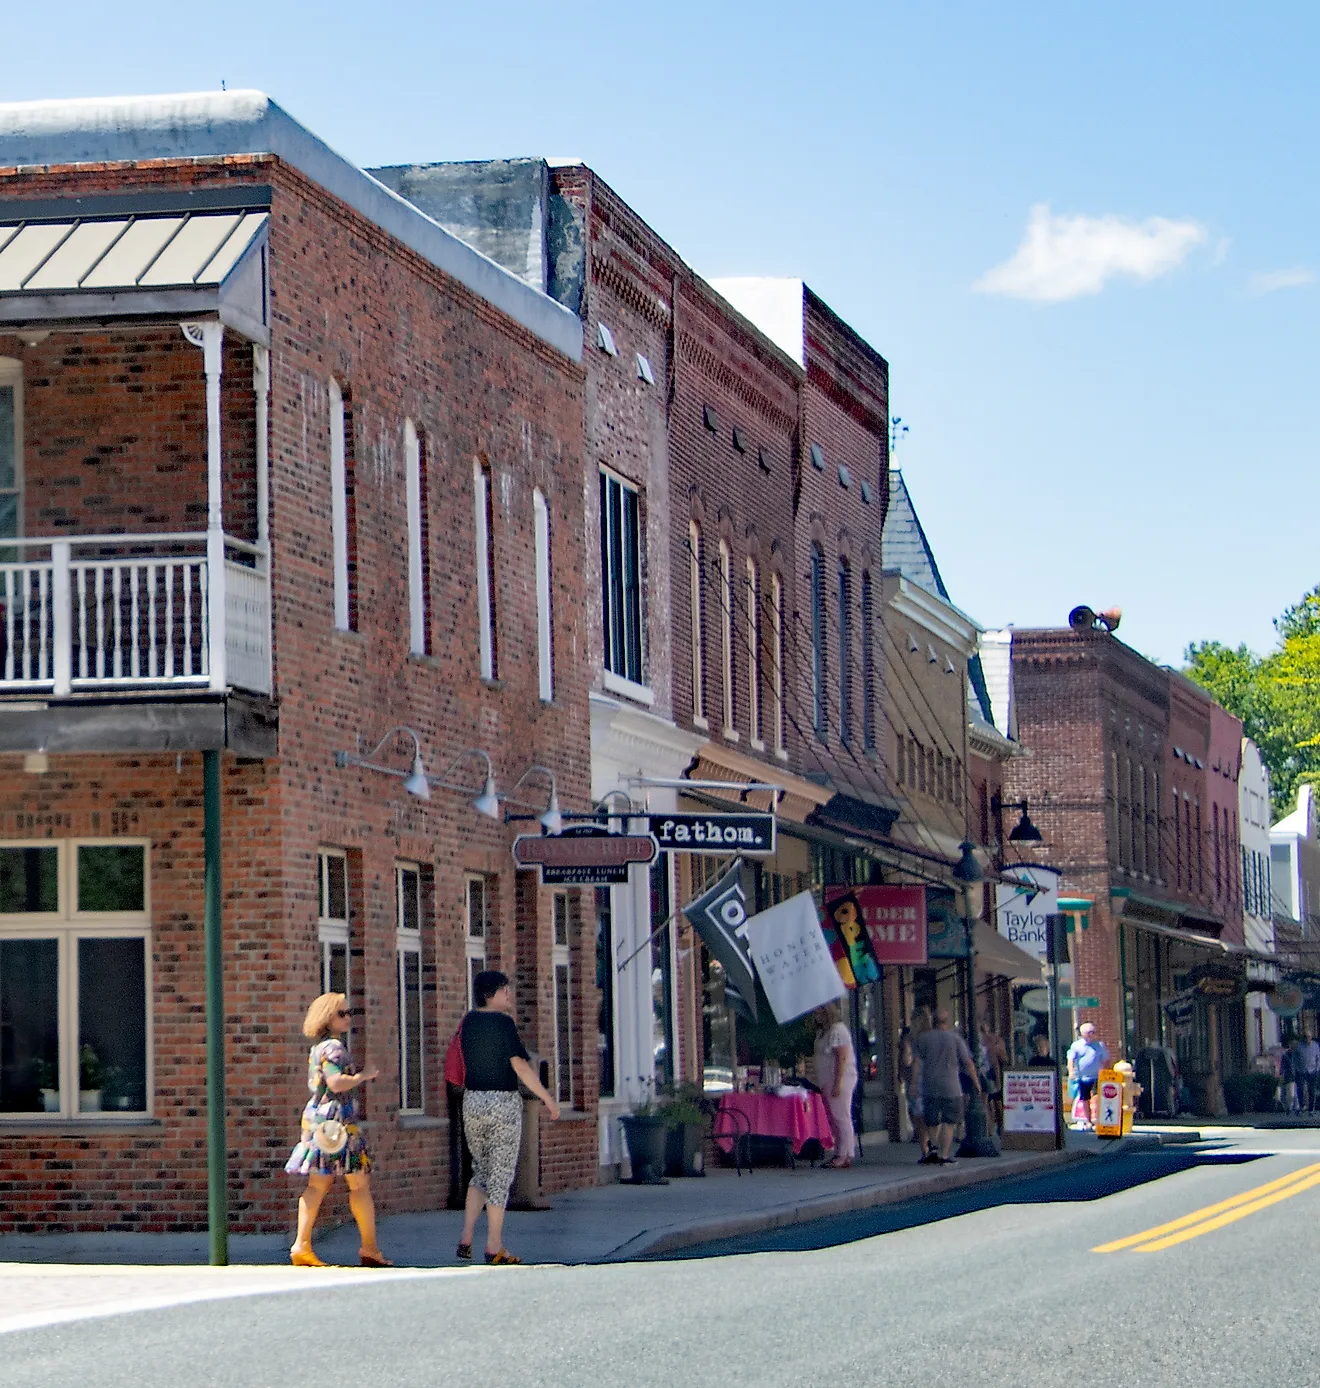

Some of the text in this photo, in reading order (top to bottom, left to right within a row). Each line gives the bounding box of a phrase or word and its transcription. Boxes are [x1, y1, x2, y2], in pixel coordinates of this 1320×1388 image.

[660, 820, 762, 844] fathom.
[1003, 910, 1046, 929] Taylo
[833, 900, 880, 985] OPEN
[1008, 927, 1046, 942] Bank
